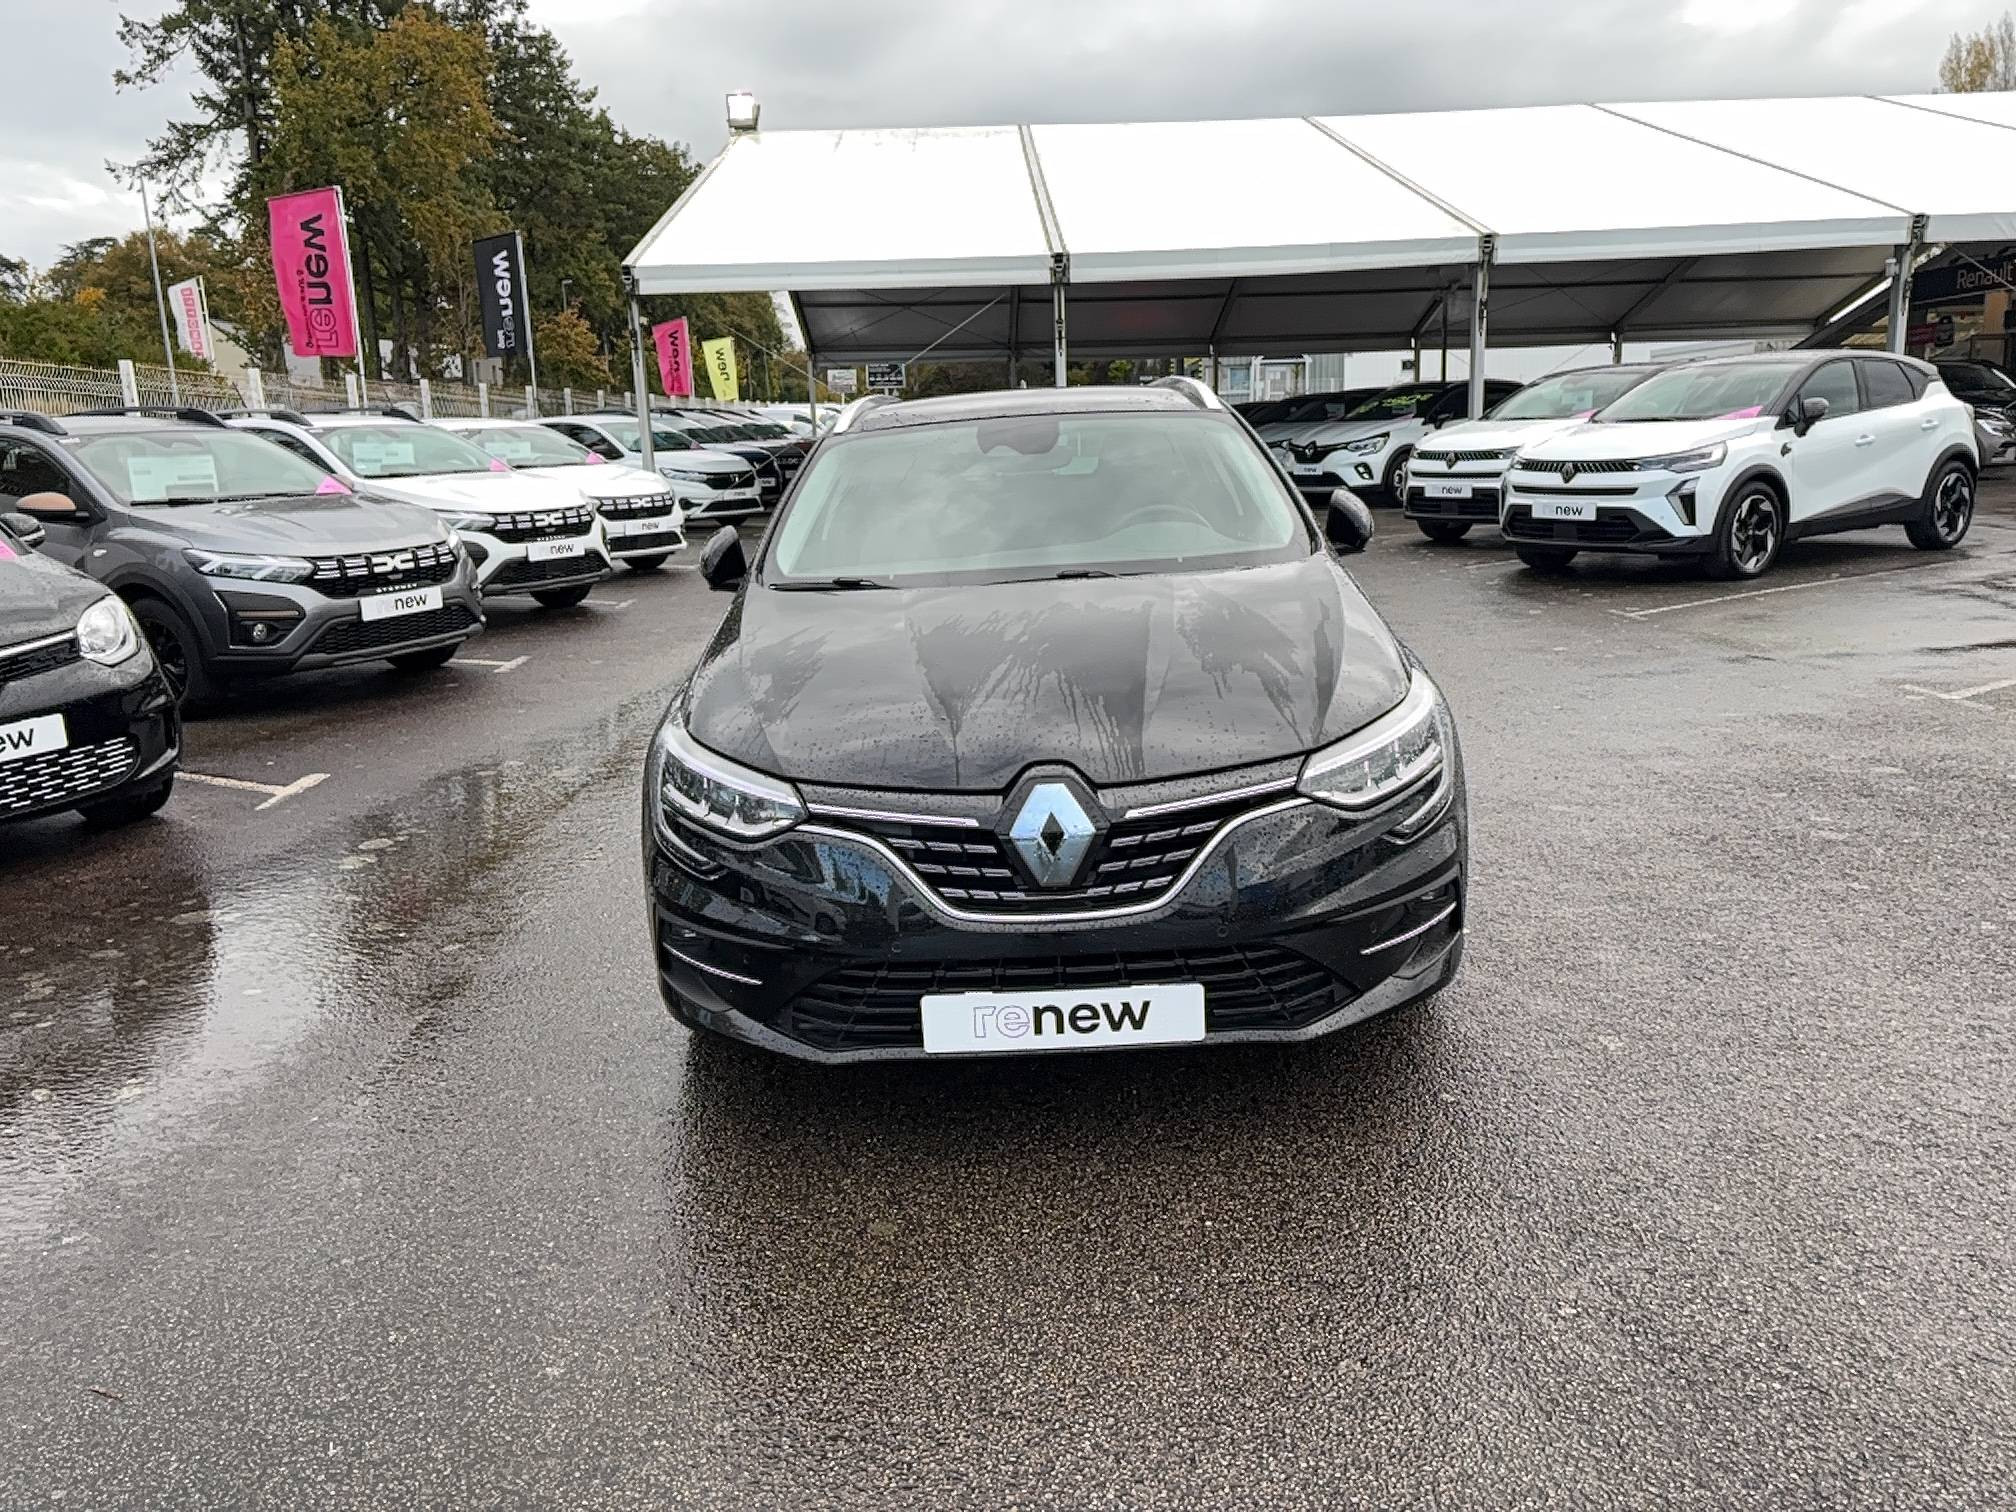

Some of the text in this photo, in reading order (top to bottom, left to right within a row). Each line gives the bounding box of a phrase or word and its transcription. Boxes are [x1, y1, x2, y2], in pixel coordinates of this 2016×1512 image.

[1956, 261, 2015, 289] Renault
[395, 594, 427, 611] new
[973, 1000, 1152, 1039] renew
